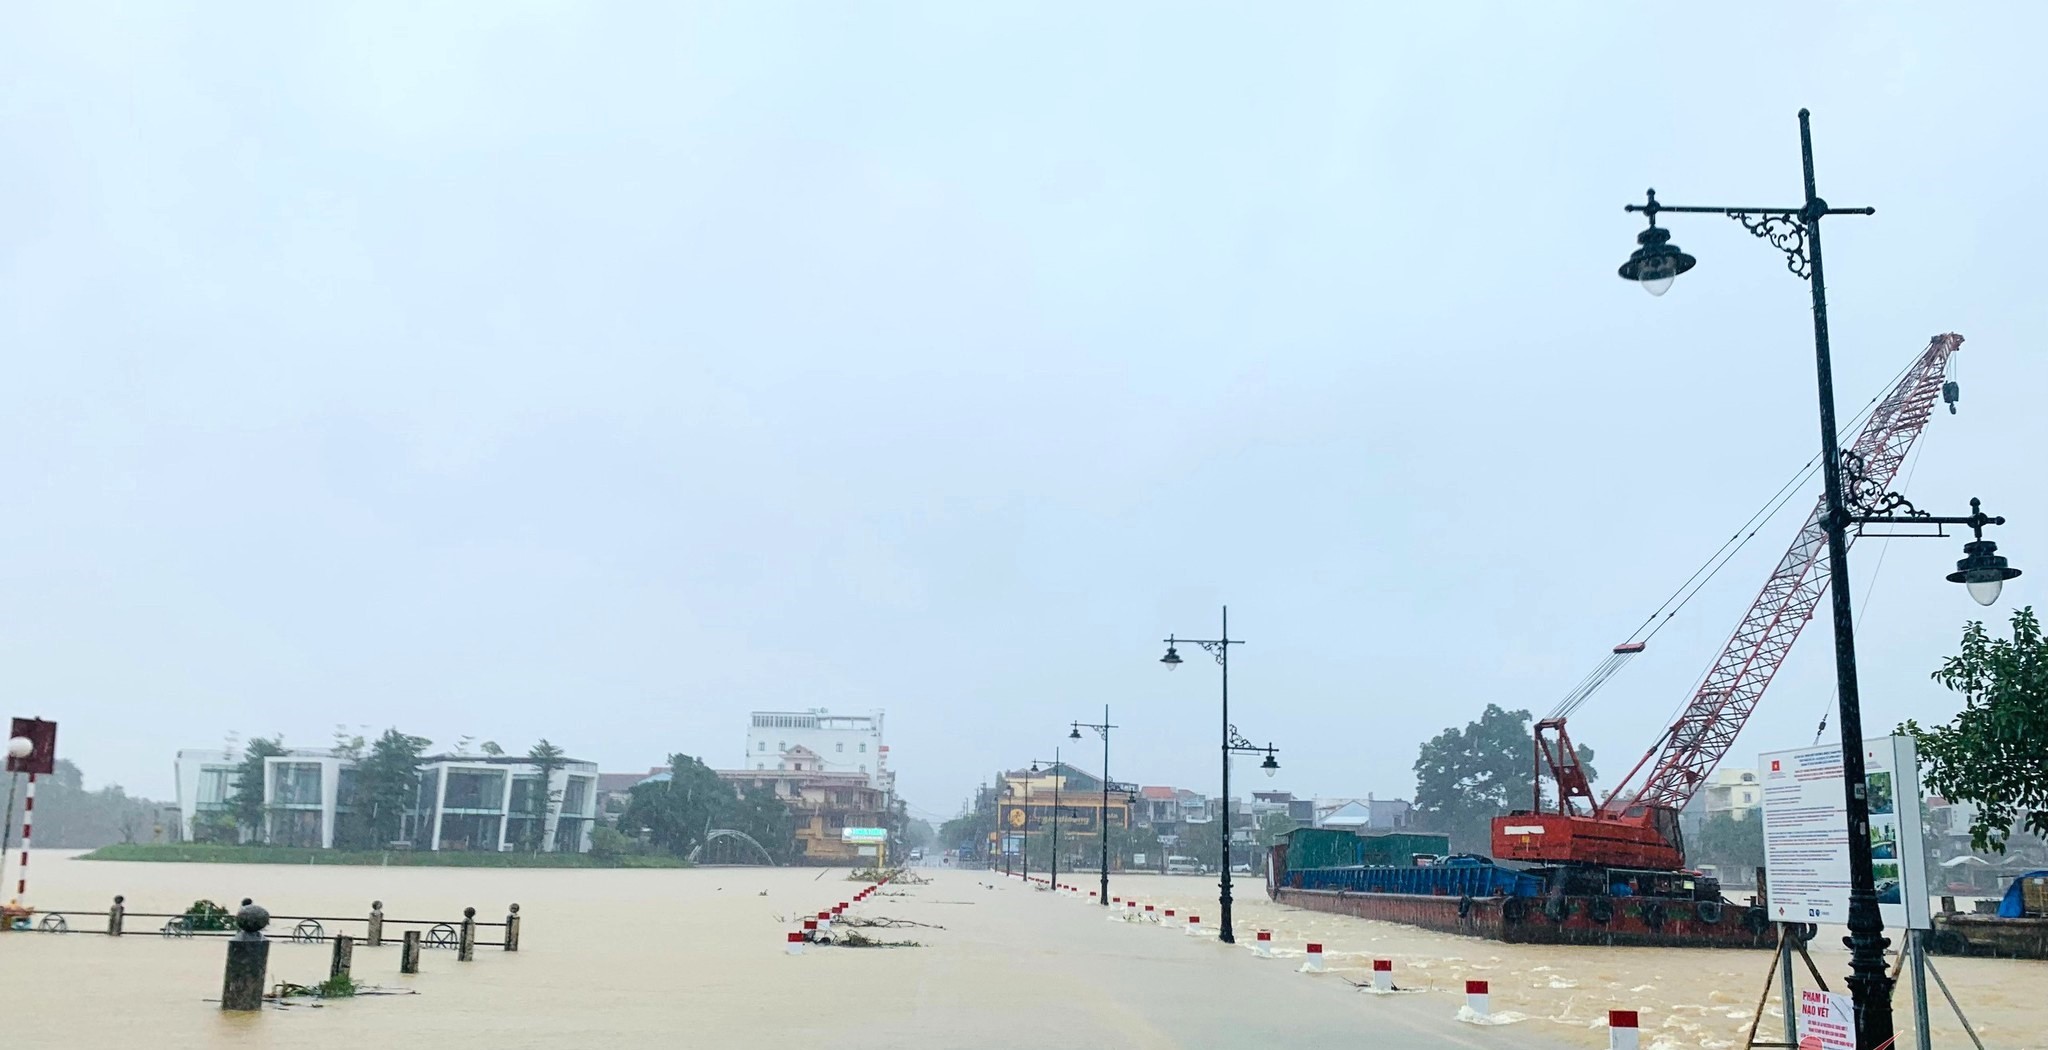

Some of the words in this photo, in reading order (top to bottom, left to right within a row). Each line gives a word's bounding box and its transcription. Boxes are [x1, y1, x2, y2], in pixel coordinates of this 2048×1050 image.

[1803, 991, 1821, 1004] PHẠM
[1802, 1004, 1816, 1017] NẠO
[1817, 1005, 1829, 1018] VÉT
